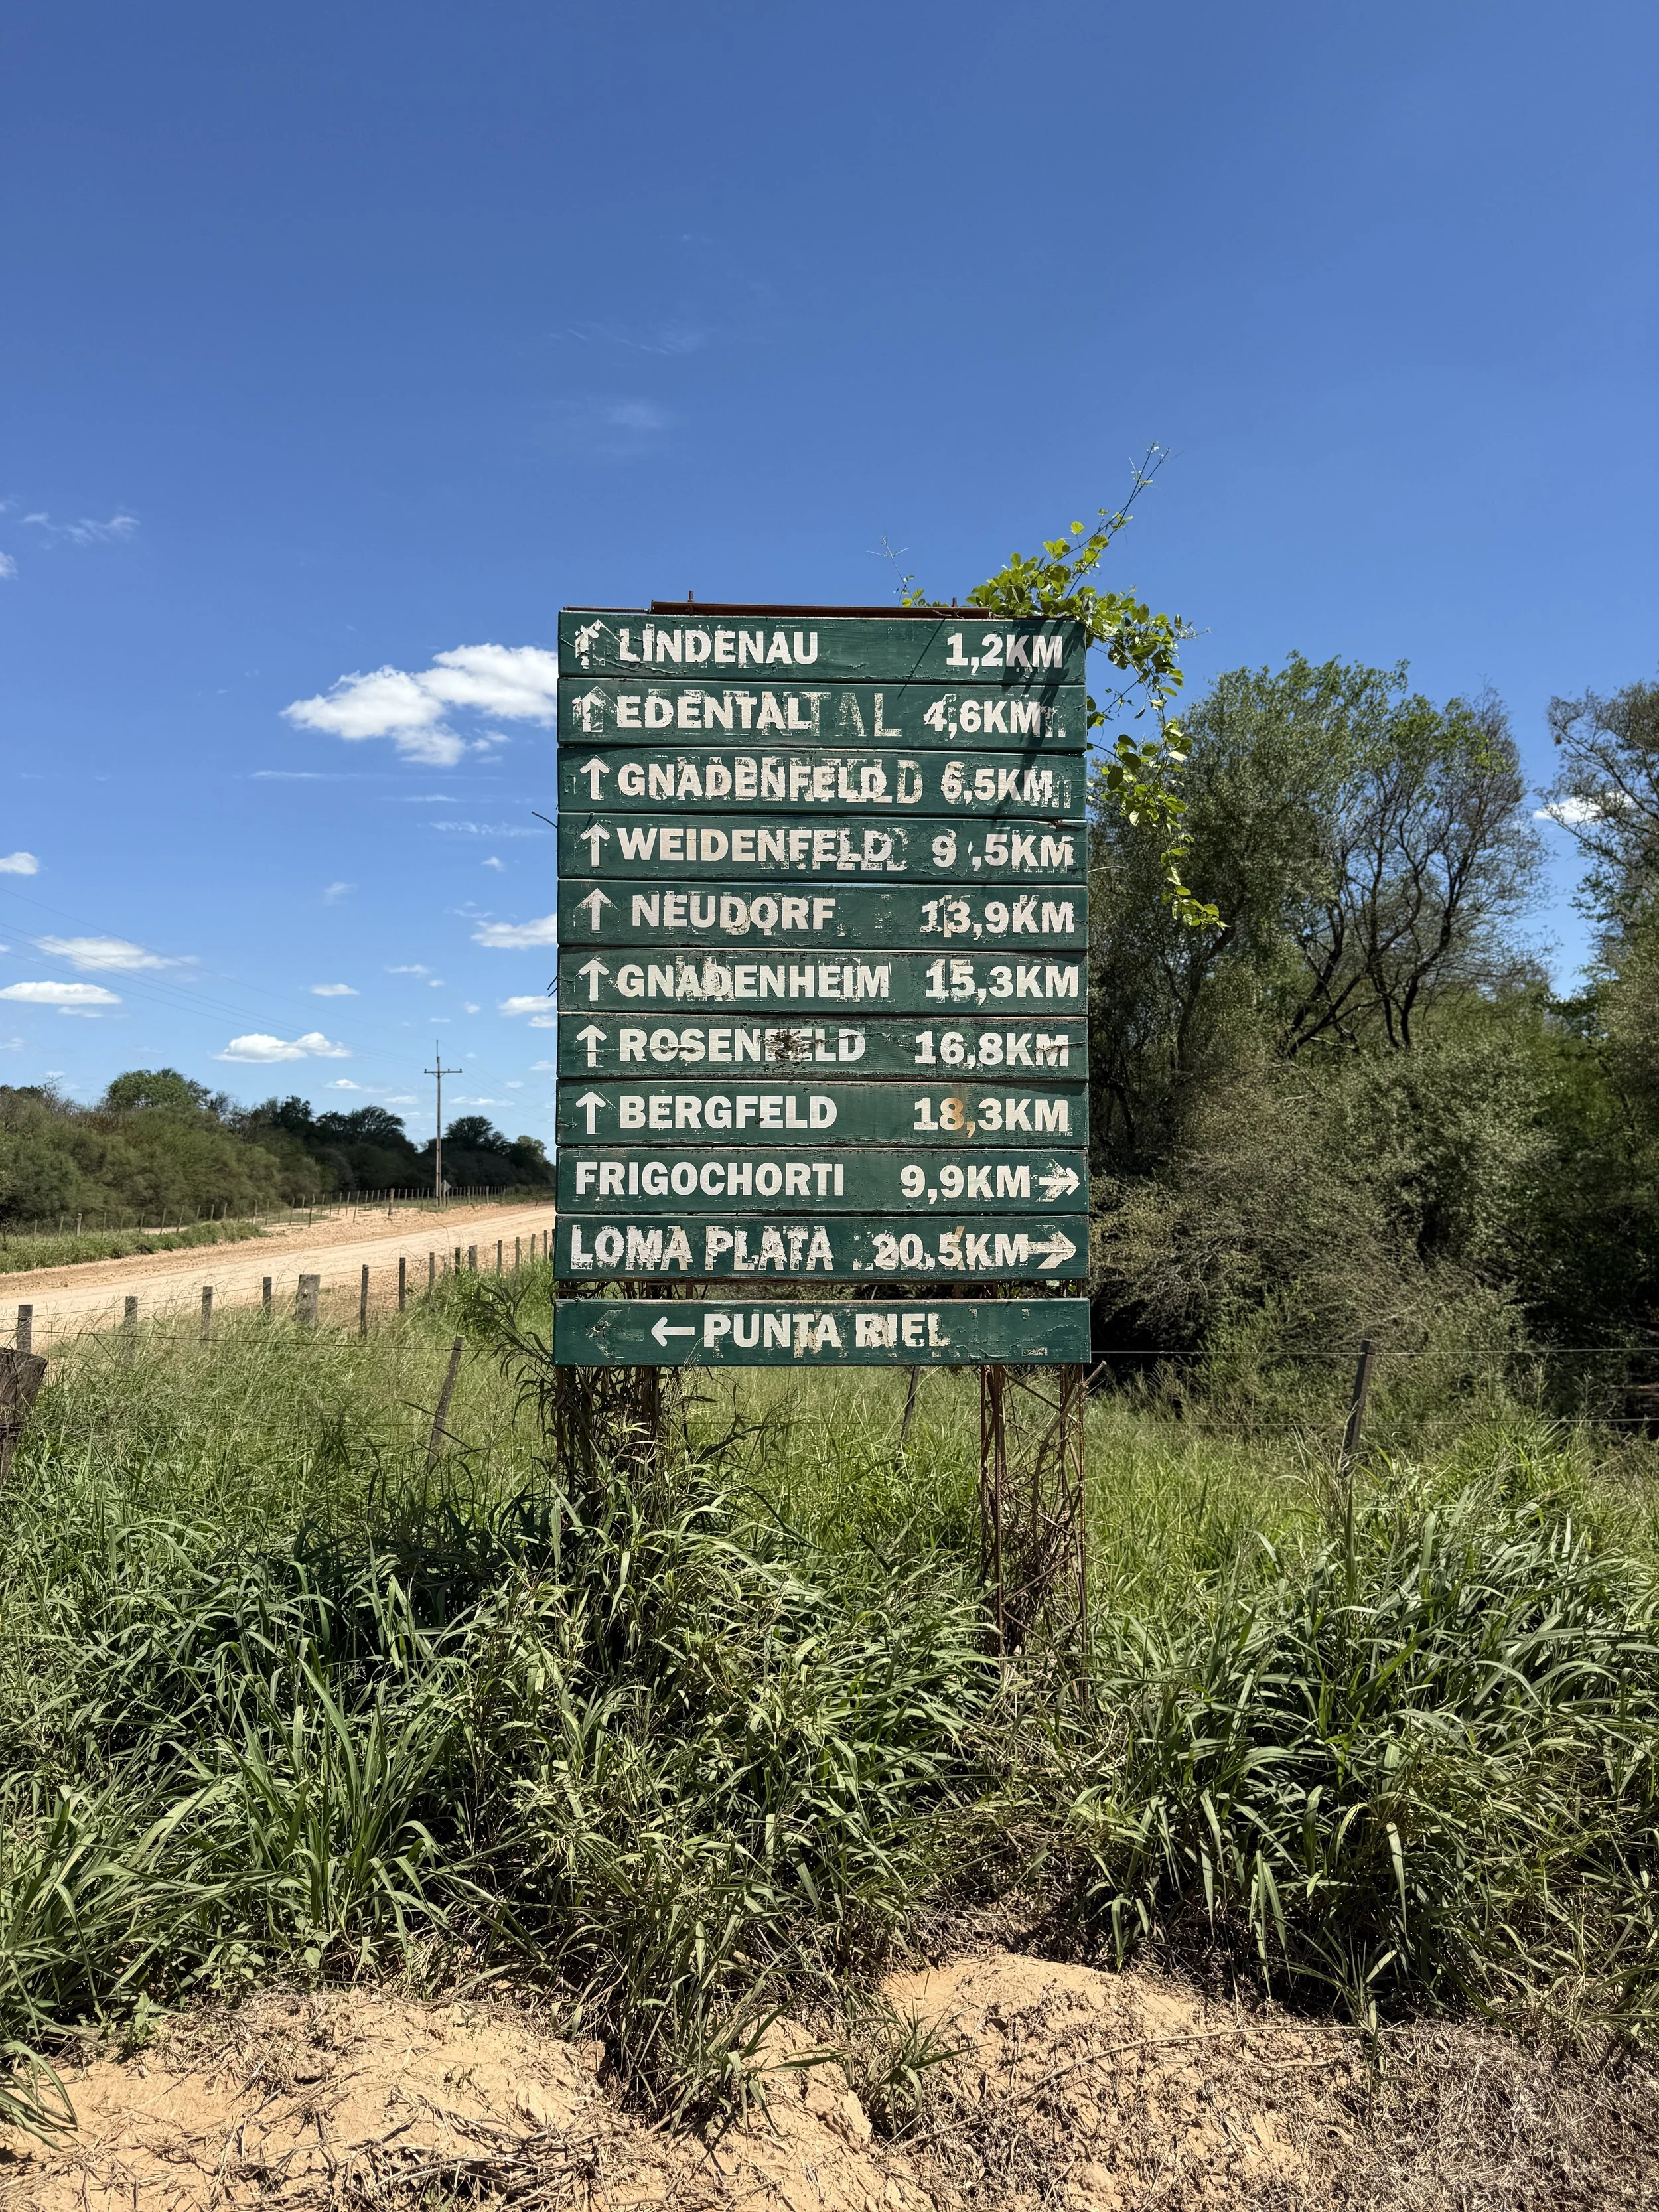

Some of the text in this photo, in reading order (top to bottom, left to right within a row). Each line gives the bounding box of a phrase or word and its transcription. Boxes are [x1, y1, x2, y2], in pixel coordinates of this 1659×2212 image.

[618, 628, 1063, 672] LINDENAU 1,2KM
[616, 696, 1041, 739] EDENTAL 4,6KM
[618, 763, 1053, 806] GNADENFELD 6,5KM
[617, 828, 893, 863] WEIDENFELD
[632, 894, 1074, 940] NEUDORF 13,9KM
[617, 964, 1078, 1004] GNADENHEIM 15,3KM
[914, 1031, 1069, 1069] 16,8KM
[620, 1095, 1068, 1137] BERGFELD 18,3KM
[576, 1161, 1031, 1204] FRIGOCHORTI 9,9KM
[571, 1224, 694, 1271] LOMA
[705, 1225, 834, 1271] PLATA
[703, 1313, 950, 1348] PUNTA RIEL
